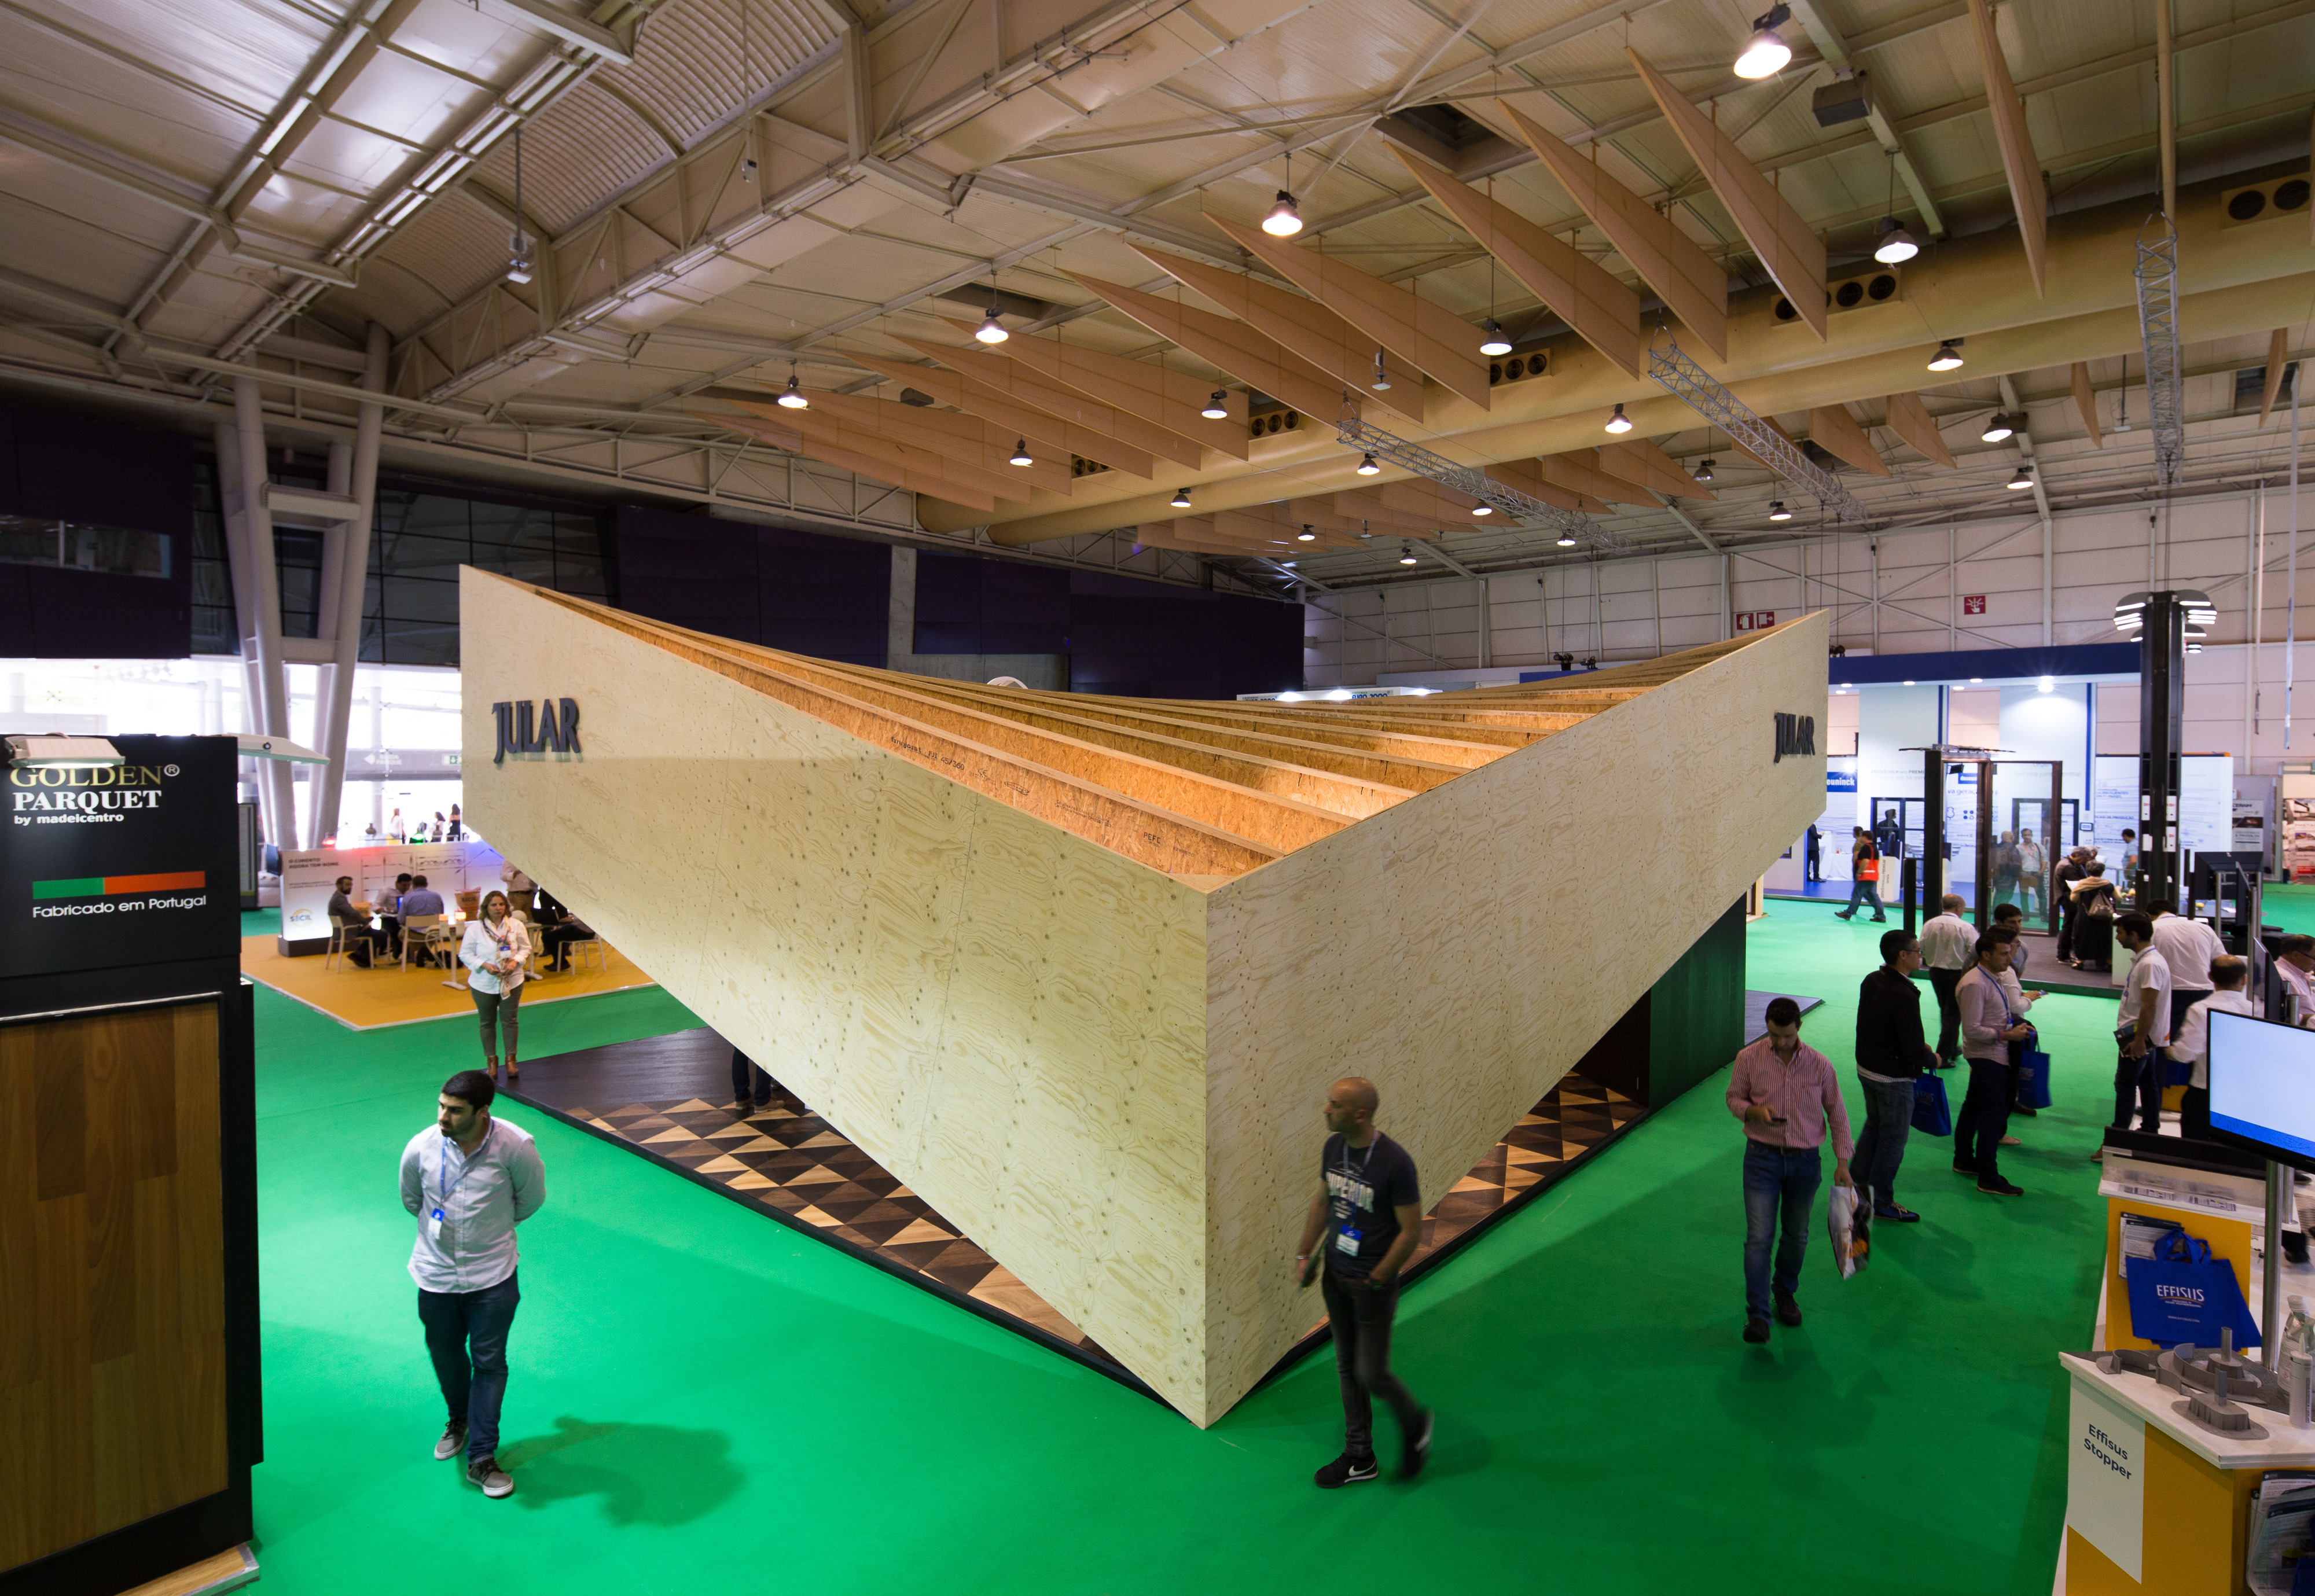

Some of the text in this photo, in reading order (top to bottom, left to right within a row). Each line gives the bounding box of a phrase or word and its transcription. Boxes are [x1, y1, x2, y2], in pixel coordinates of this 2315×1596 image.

[492, 698, 580, 764] JULAR
[1774, 712, 1816, 763] JULAR
[941, 757, 965, 770] 45/360
[10, 766, 163, 787] GOLDEN
[1827, 778, 1855, 786] euninck
[12, 790, 162, 814] PARQUET
[14, 813, 124, 826] by madeicentro
[1144, 832, 1162, 844] PEFC
[32, 895, 206, 918] Fabricado em Portugal
[2156, 1284, 2204, 1302] EFFISUS
[2089, 1424, 2128, 1460] Effisus
[2084, 1438, 2132, 1480] Stopper
